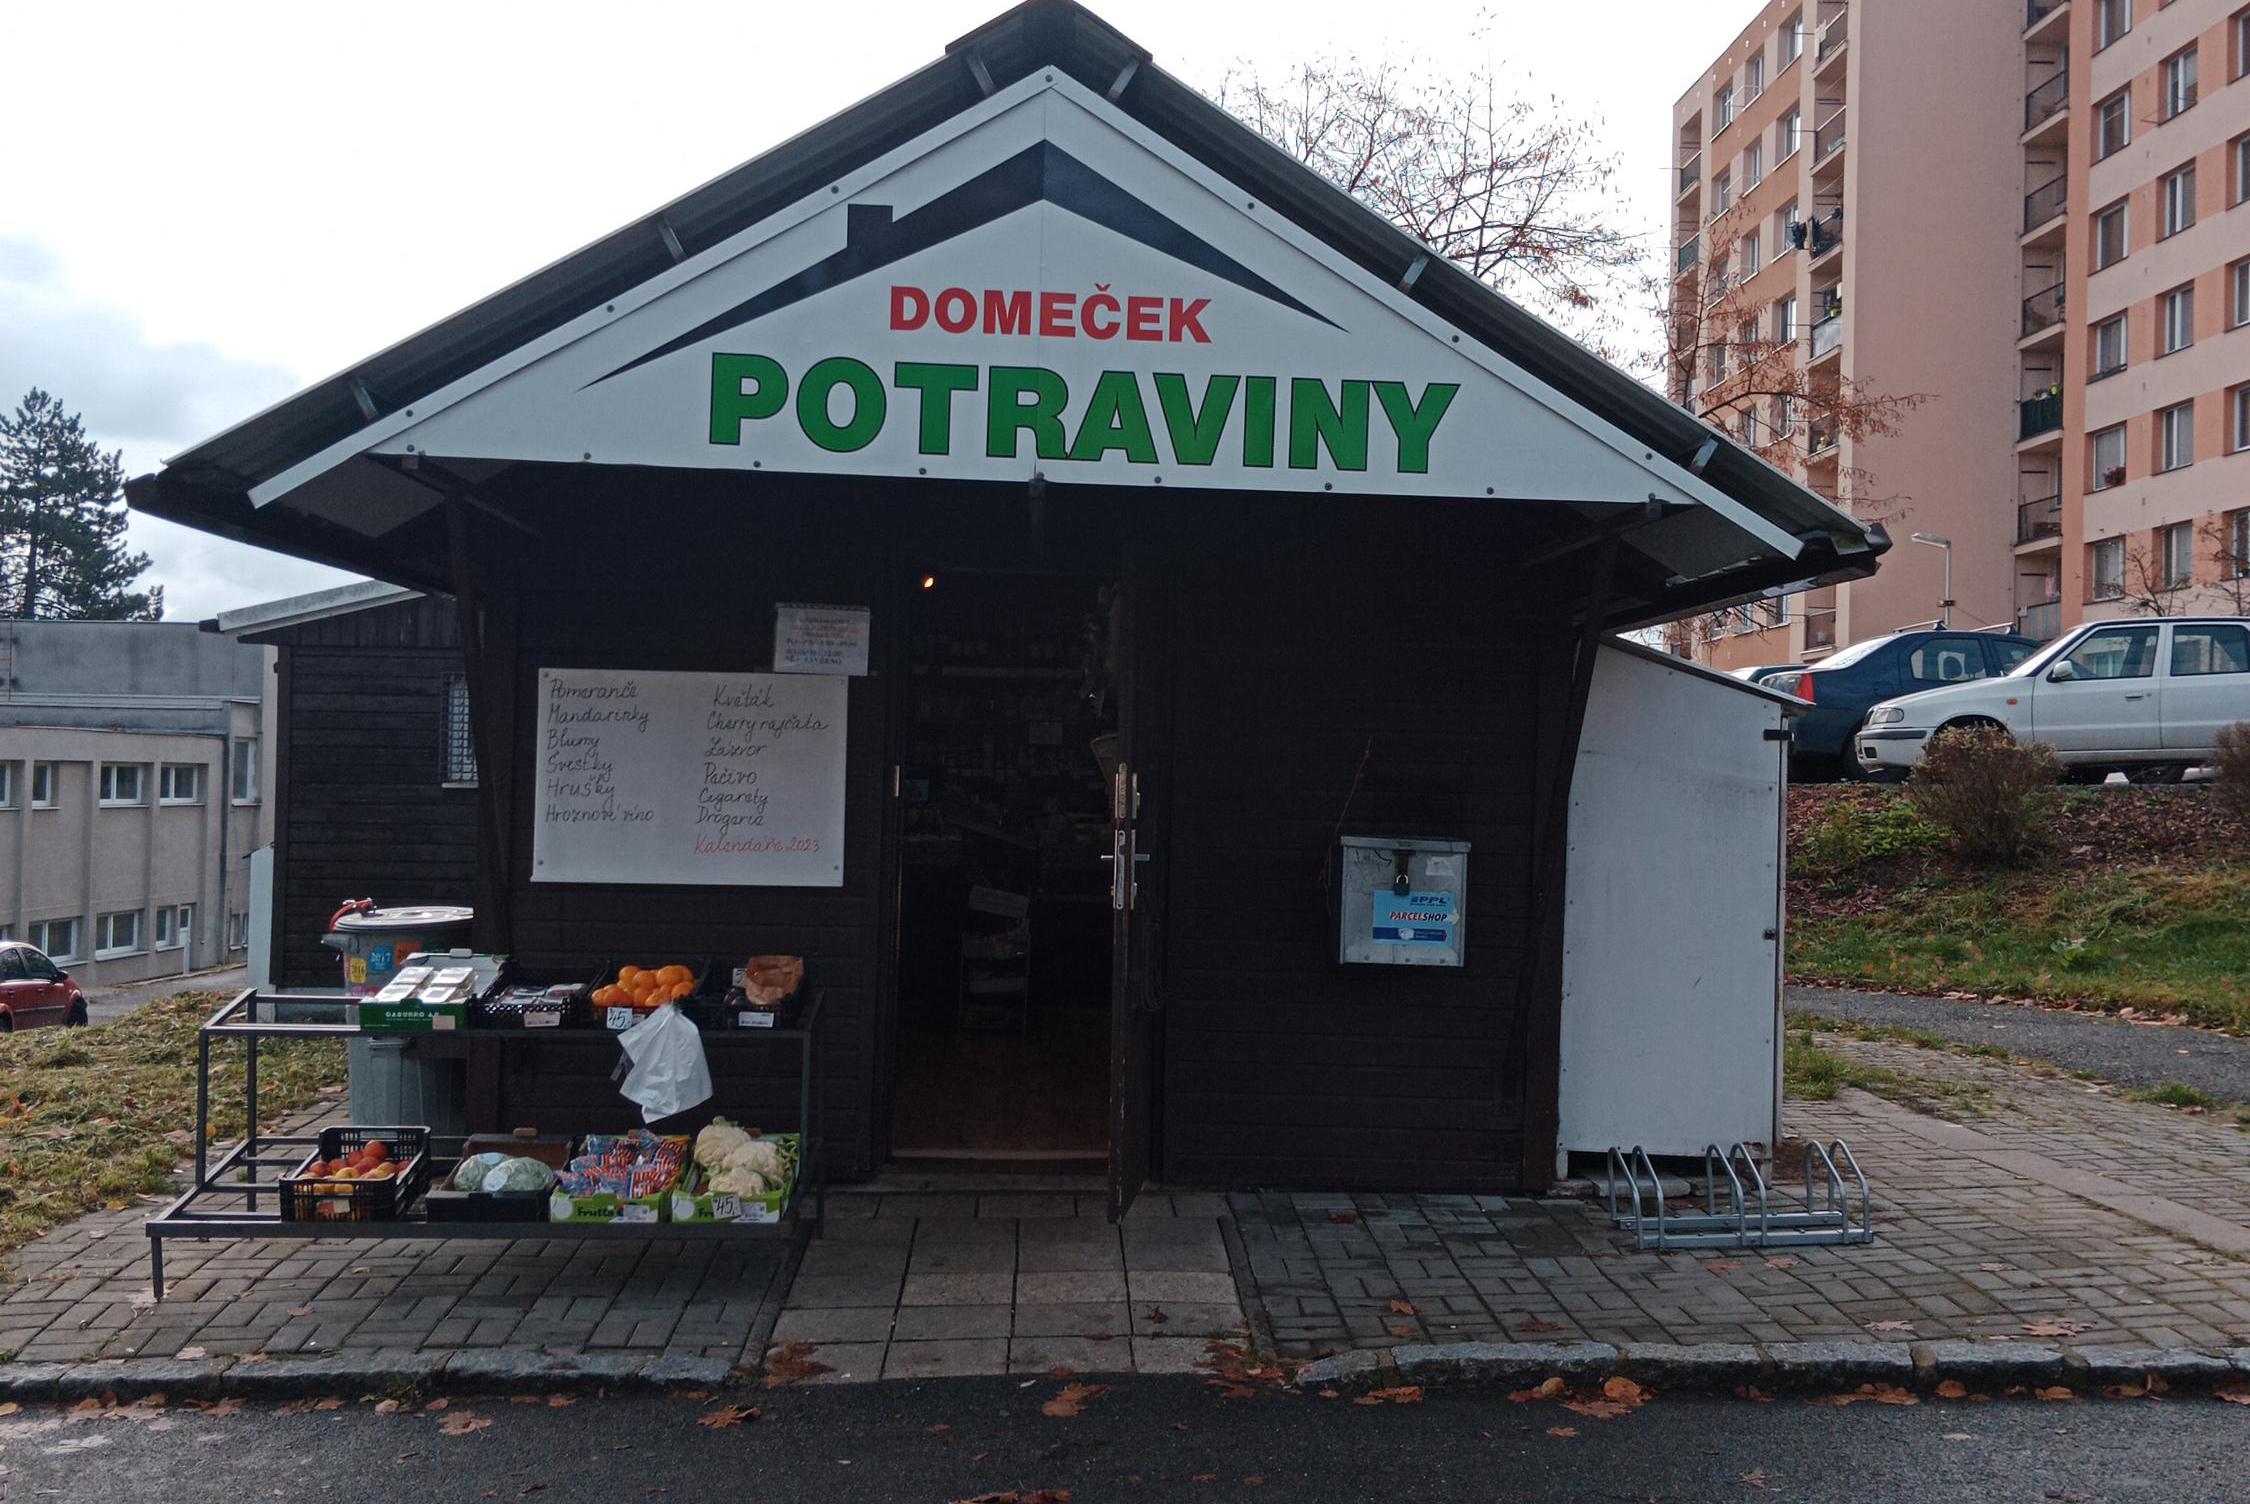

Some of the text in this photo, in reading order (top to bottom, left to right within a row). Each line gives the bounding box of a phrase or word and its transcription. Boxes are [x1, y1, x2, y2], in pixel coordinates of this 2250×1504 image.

[889, 284, 1212, 343] DOMEČEK
[709, 351, 1461, 475] POTRAVINY
[551, 678, 639, 699] Pomeranče
[548, 702, 649, 733] Mandarinky
[707, 711, 755, 744] Cherry
[547, 727, 600, 757] Blumy
[698, 787, 769, 814] Cigarety
[696, 804, 765, 836] Drogerie
[1418, 895, 1447, 904] PPL
[1389, 911, 1448, 922] PARCELSHOP
